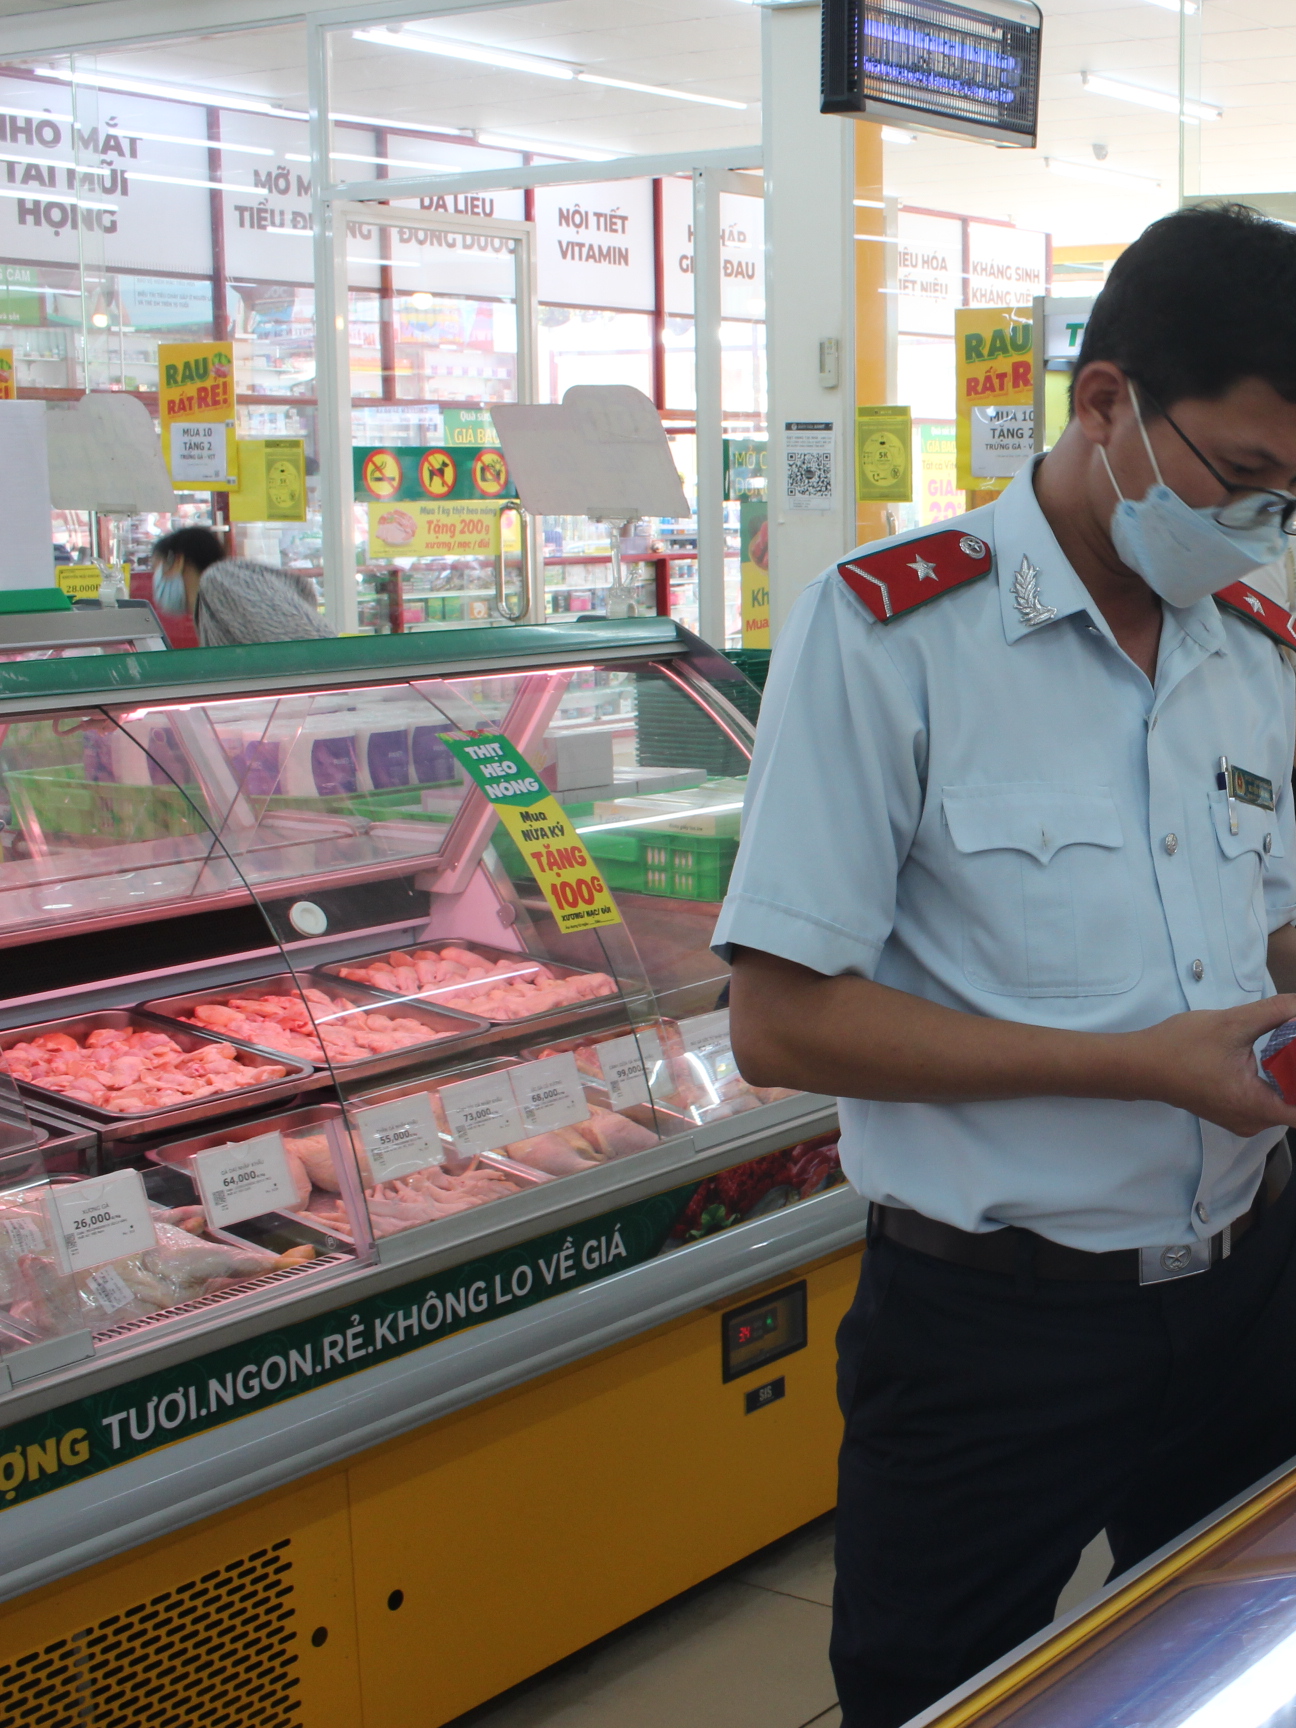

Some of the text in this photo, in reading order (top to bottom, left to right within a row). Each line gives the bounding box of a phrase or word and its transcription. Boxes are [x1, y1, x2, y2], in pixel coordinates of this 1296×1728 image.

[17, 198, 118, 237] HỌNG
[234, 198, 285, 230] TIỂU
[558, 204, 628, 235] NỘI TIẾT
[557, 239, 629, 267] VITAMIN
[898, 247, 949, 272] IÊU HÓA
[722, 258, 756, 280] ĐAU
[972, 258, 1041, 284] KHÁNG SINH
[964, 323, 1033, 364] RAU
[165, 357, 211, 389] RAU
[966, 366, 1008, 397] RẤT
[167, 376, 229, 417] RẤT RẺ!
[182, 428, 213, 437] MUA 10
[454, 425, 475, 444] GIÁ
[990, 425, 1024, 442] TẶNG
[207, 441, 212, 451] 2
[985, 442, 1010, 450] TRỨNG
[1012, 441, 1022, 450] GÀ
[426, 519, 457, 539] Tặng
[459, 518, 484, 535] 200
[464, 742, 504, 761] THỊT
[484, 777, 540, 799] NÓNG
[519, 810, 548, 824] Mua
[530, 843, 587, 878] TẶNG
[616, 1064, 642, 1078] 99,000
[531, 1088, 558, 1103] 68,000
[463, 1107, 491, 1122] 73,000
[380, 1129, 410, 1145] 55,000
[223, 1170, 257, 1187] 64,000
[73, 1211, 112, 1230] 26,000
[495, 1265, 534, 1305] LO
[538, 1236, 577, 1285] VỀ
[581, 1223, 628, 1270] GIÁ
